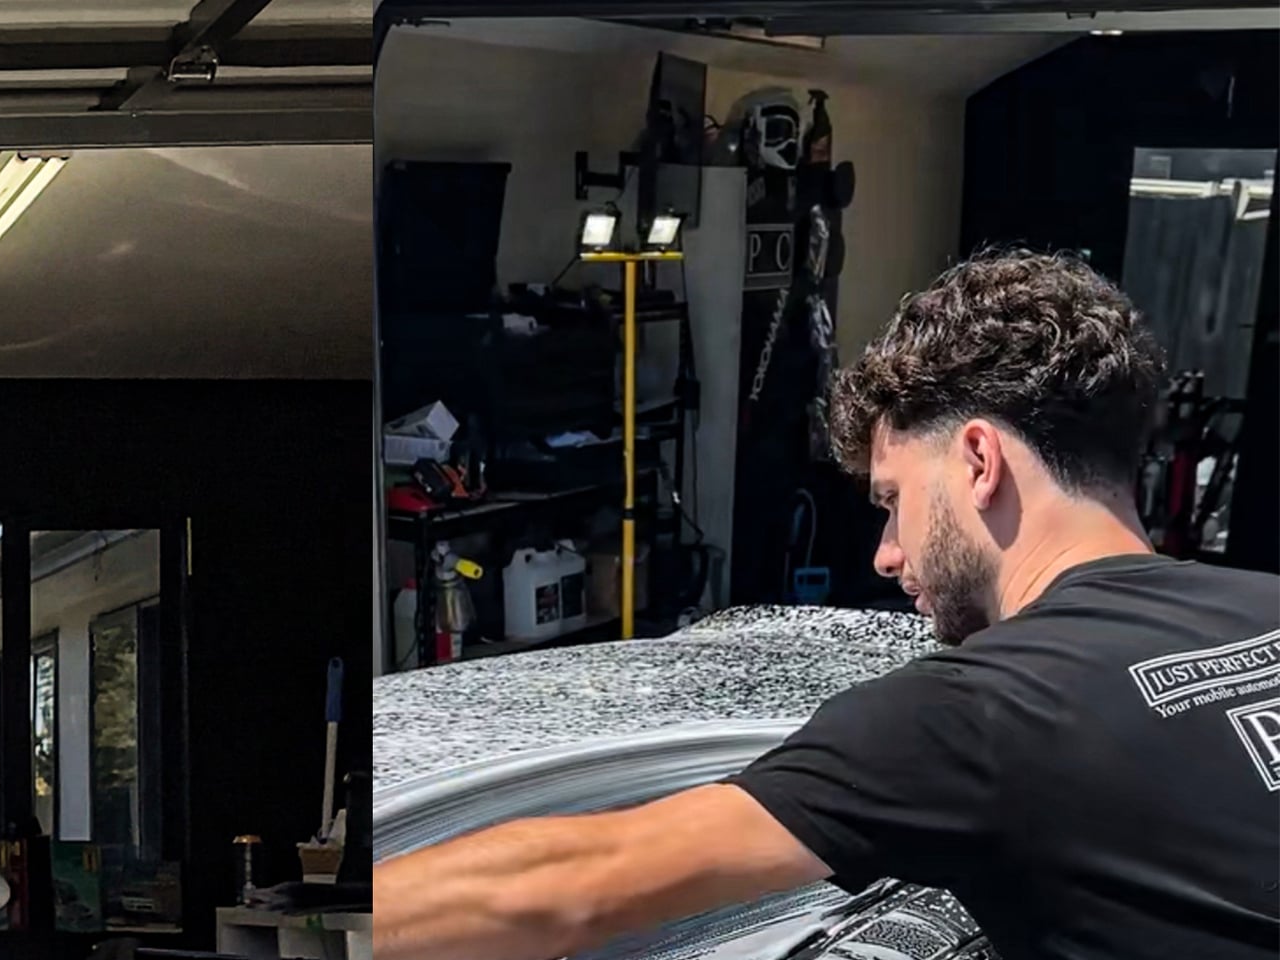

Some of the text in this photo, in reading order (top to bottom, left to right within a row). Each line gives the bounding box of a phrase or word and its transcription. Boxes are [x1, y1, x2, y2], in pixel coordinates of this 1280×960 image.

[1150, 644, 1277, 692] JUST PERFECT
[1155, 673, 1280, 719] Your mobile automot
